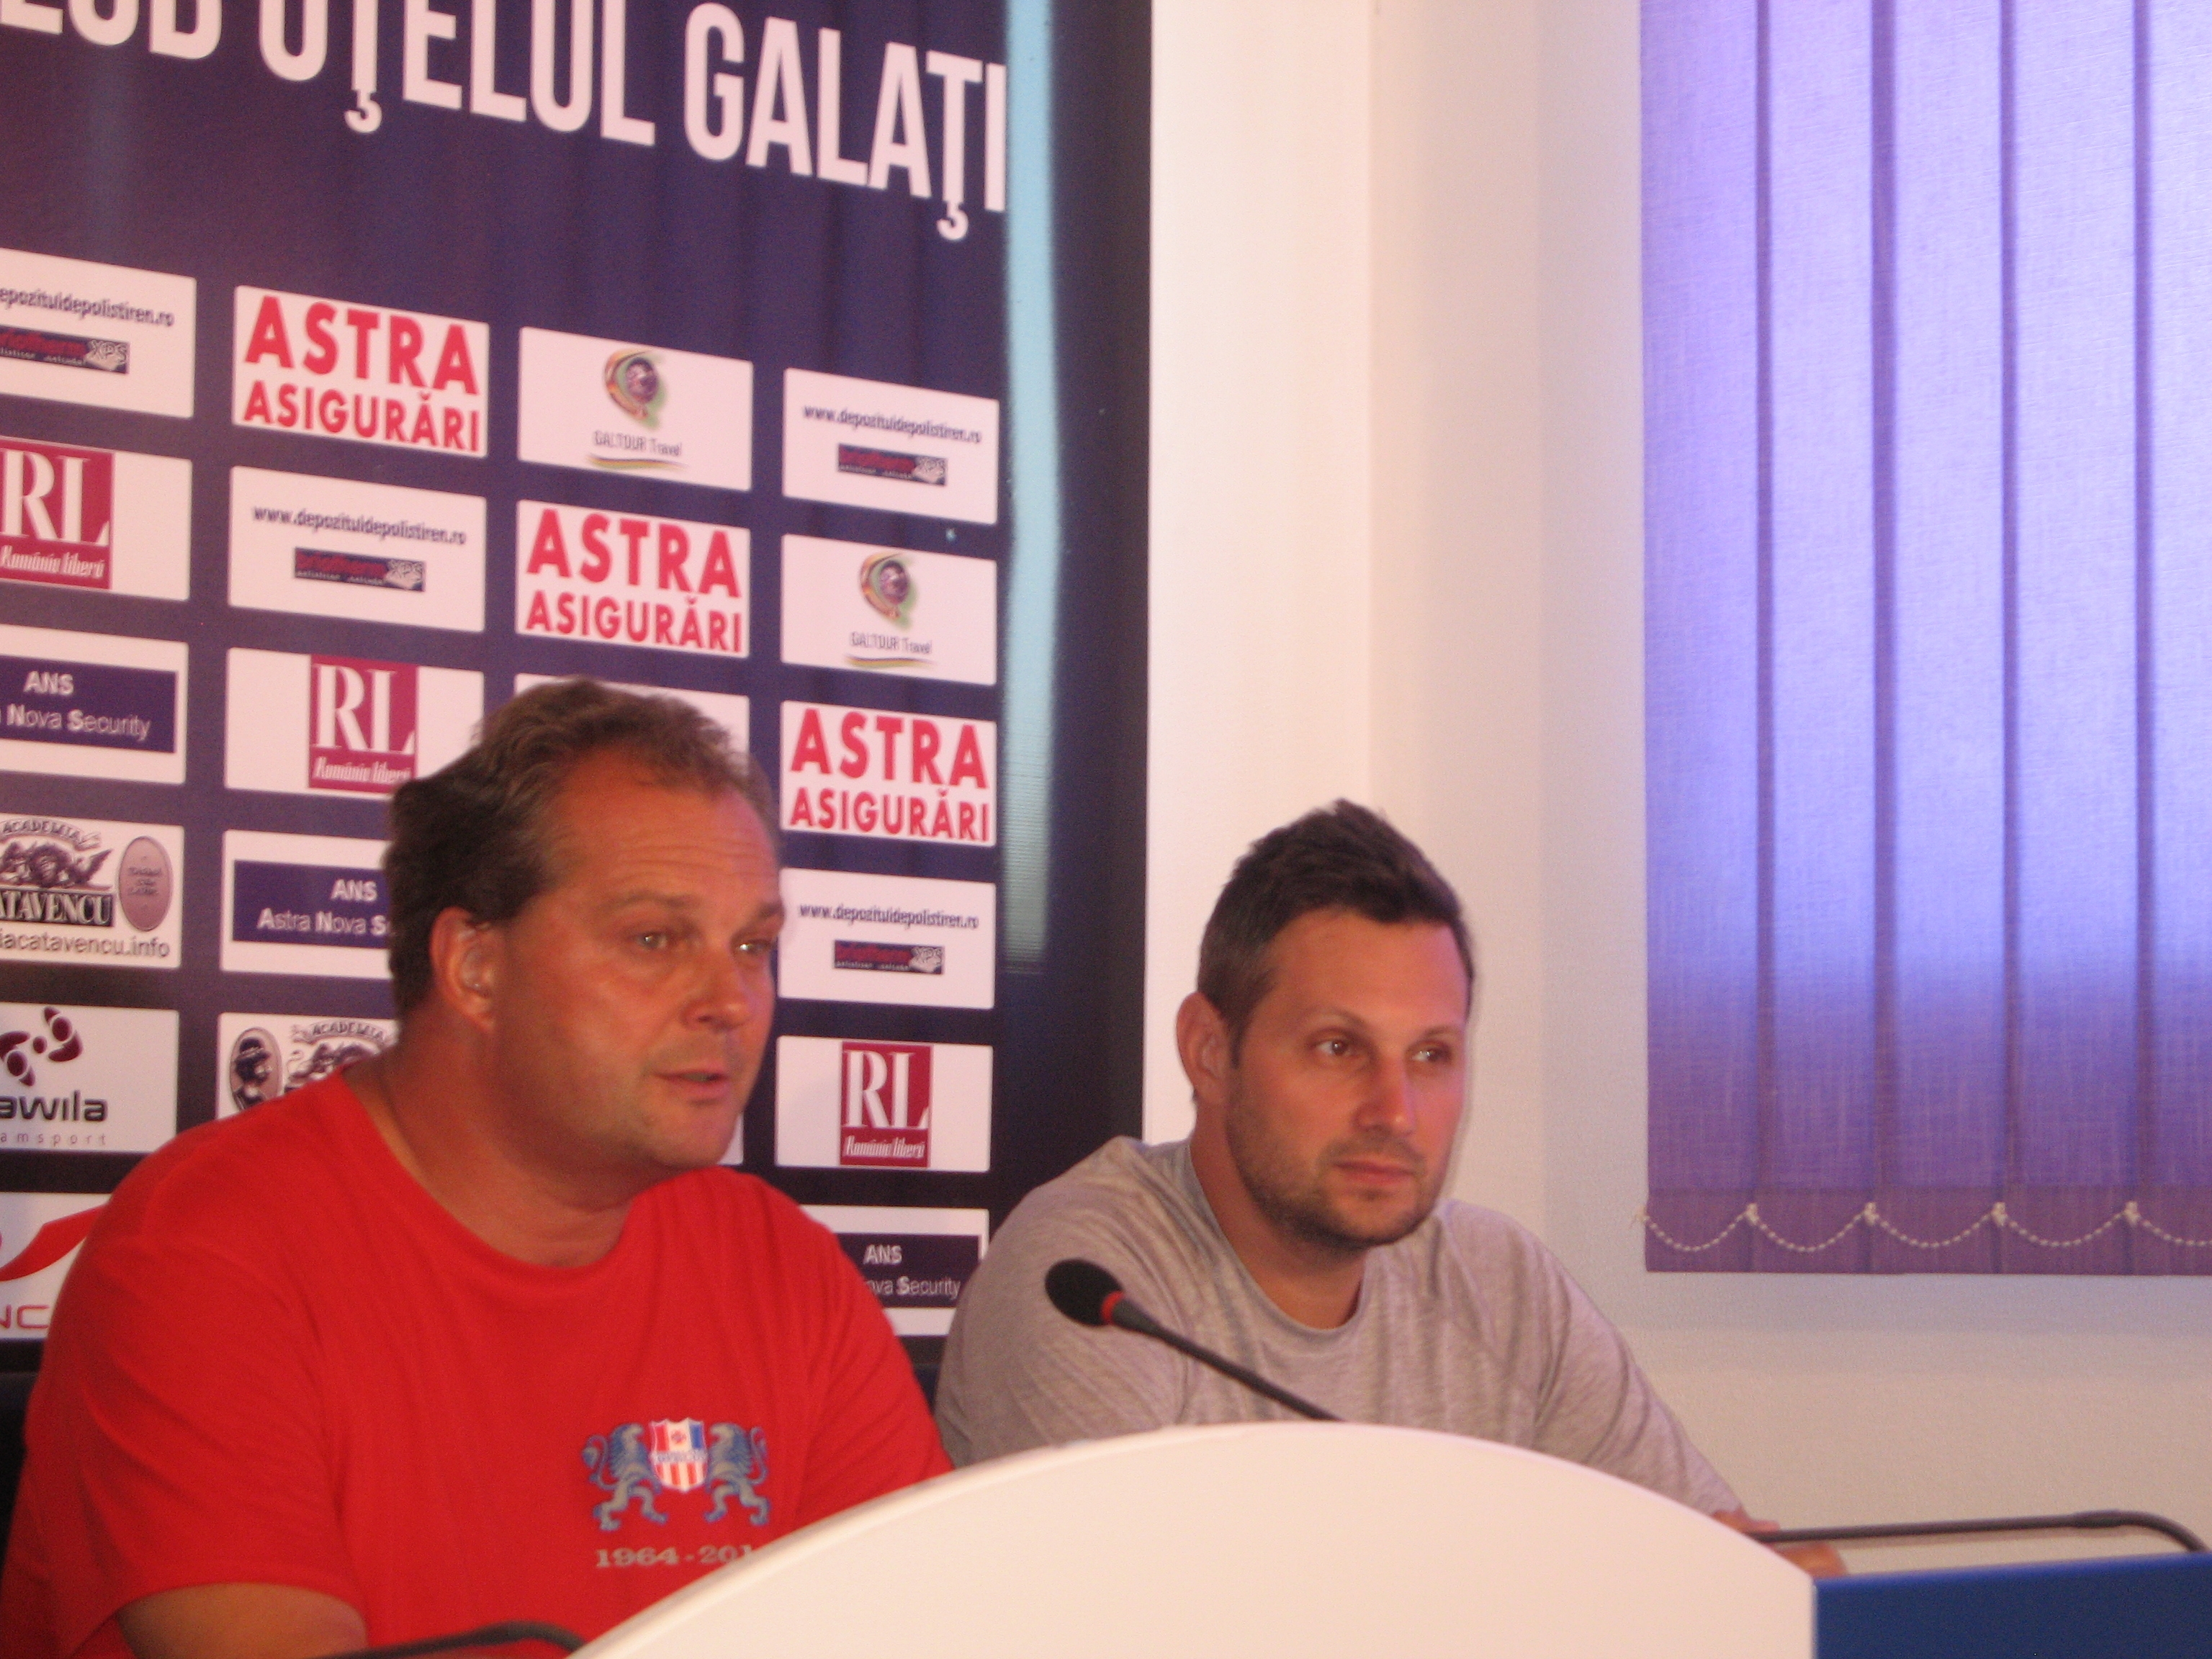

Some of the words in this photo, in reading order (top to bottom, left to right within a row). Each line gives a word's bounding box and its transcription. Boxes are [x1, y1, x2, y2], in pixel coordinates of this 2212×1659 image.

[684, 2, 1006, 241] GALAŢI
[245, 295, 480, 396] ASTRA
[243, 379, 480, 453] ASIGURĂRI
[1, 450, 109, 547] RL
[526, 508, 741, 599] ASTRA
[525, 590, 742, 654] ASIGURĂRI
[23, 670, 74, 696] ANS
[311, 662, 416, 755] RL
[6, 703, 63, 730] Nova
[67, 709, 151, 743] Security
[789, 707, 989, 789] ASTRA
[788, 786, 990, 842] ASIGURĂRI
[256, 907, 311, 932] Astra
[315, 910, 367, 935] Nova
[330, 878, 377, 902] ANS
[841, 1049, 930, 1129] RL
[863, 1244, 903, 1265] ANS
[896, 1275, 962, 1300] Security
